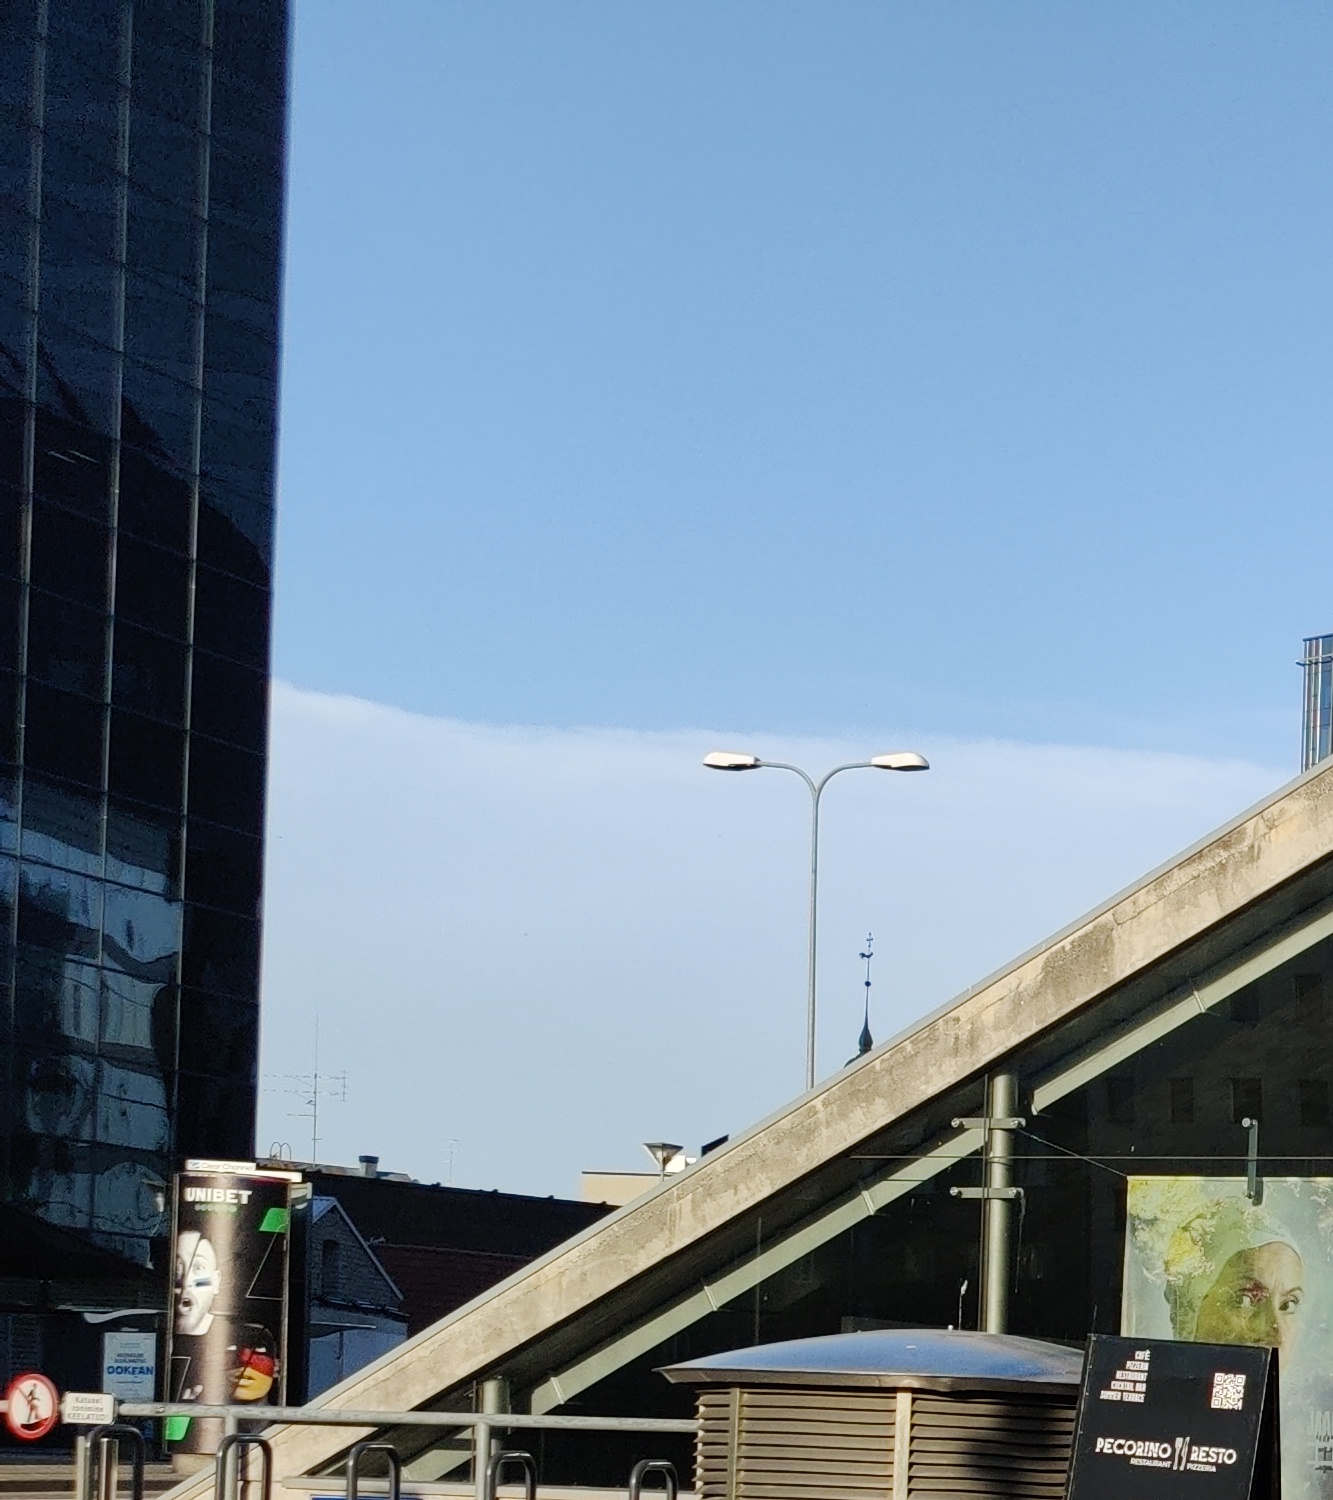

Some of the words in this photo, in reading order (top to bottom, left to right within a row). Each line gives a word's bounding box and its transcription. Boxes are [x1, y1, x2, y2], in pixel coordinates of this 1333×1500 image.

[185, 1187, 252, 1204] UNIBET
[107, 1365, 154, 1376] OOKEAN
[1095, 1437, 1172, 1458] PECORINO
[1190, 1445, 1237, 1465] RESTO
[1129, 1457, 1172, 1468] RESTAURANT
[1187, 1463, 1216, 1472] PIZZERIA
